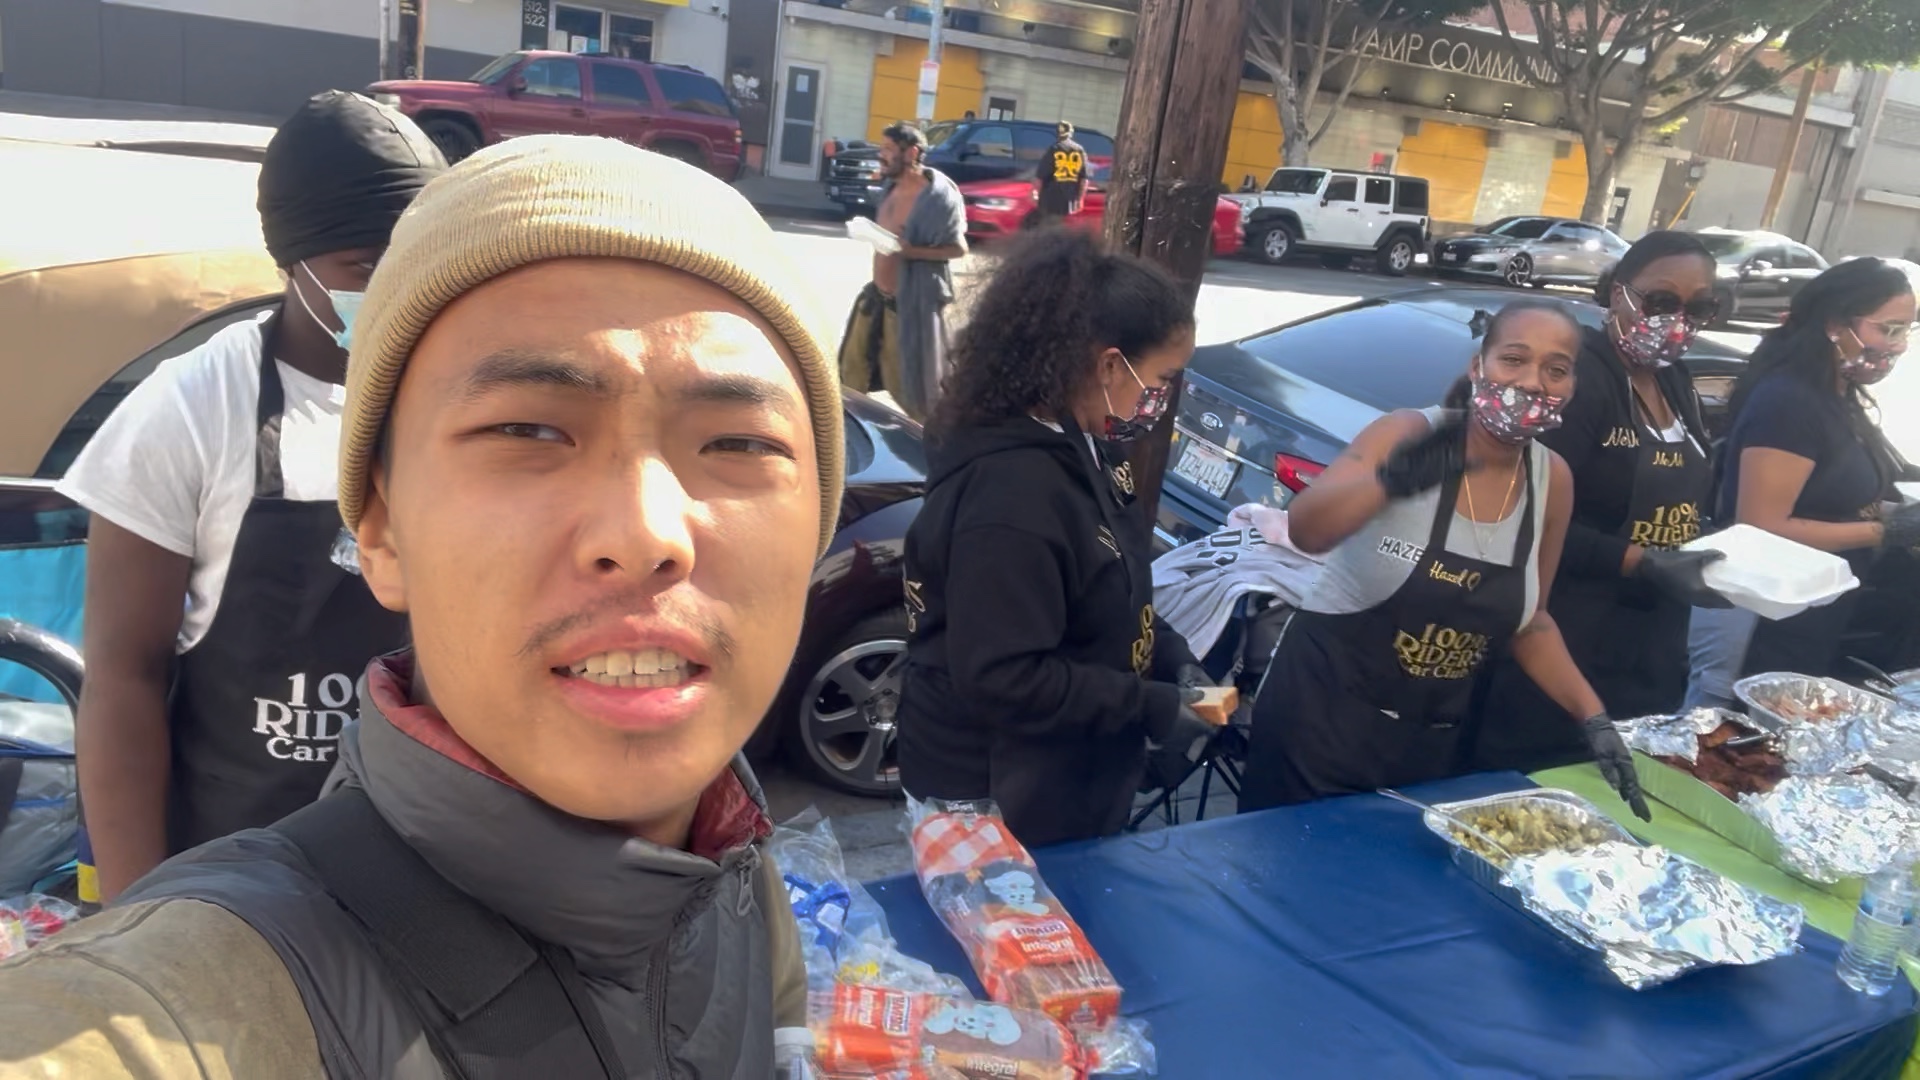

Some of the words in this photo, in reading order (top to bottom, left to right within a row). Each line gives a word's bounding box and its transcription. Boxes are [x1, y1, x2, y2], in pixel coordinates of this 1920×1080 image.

[287, 672, 361, 708] 10
[252, 696, 355, 740] RID
[266, 736, 336, 762] Car
